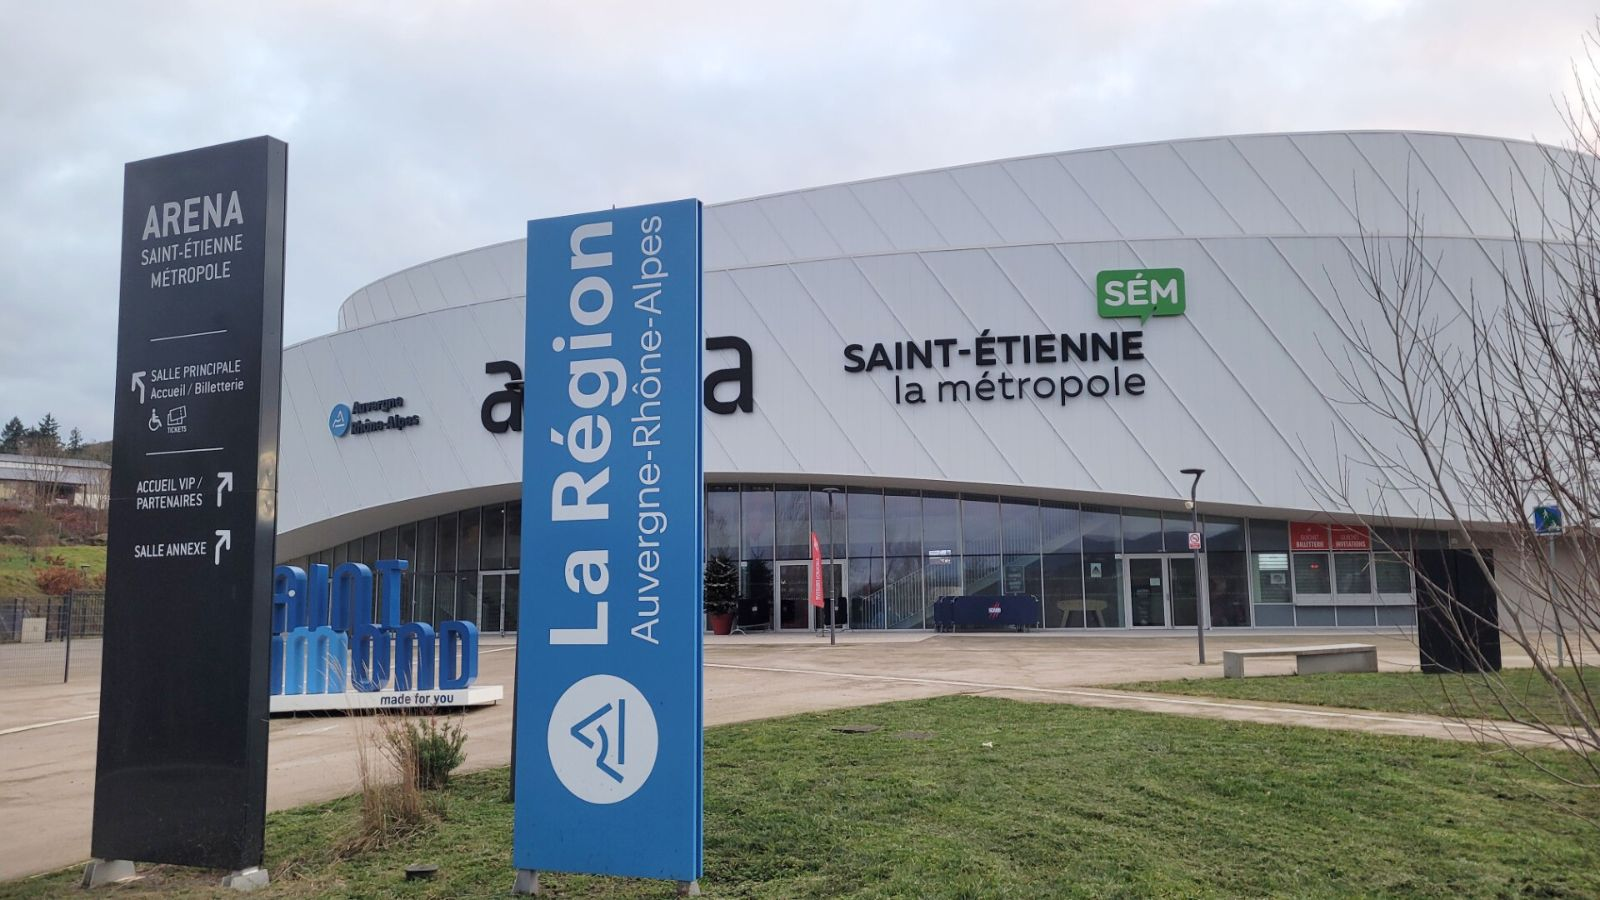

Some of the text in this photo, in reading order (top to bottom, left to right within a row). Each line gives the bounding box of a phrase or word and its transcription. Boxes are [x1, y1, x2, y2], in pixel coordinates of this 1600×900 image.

[142, 190, 244, 241] ARENA
[141, 234, 243, 266] SAINT-ÉTIENNE
[151, 261, 231, 288] MÉTROPOLE
[1104, 272, 1178, 307] SÉM
[843, 329, 1145, 373] SAINT-ÉTIENNE
[151, 360, 242, 382] SALLE PRINCIPALE
[150, 378, 244, 400] Accueil / Billetterie
[895, 366, 1147, 406] la métropole
[352, 396, 404, 414] Auvergne
[351, 414, 420, 435] Rhône-Alpes
[549, 221, 627, 644] La Région
[630, 215, 669, 645] Auvergne-Rhône-Alpes
[136, 476, 203, 493] ACCUEIL VIP /
[136, 493, 203, 510] PARTENAIRES
[134, 542, 207, 558] SALLE ANNEXE
[380, 692, 454, 705] made for you
